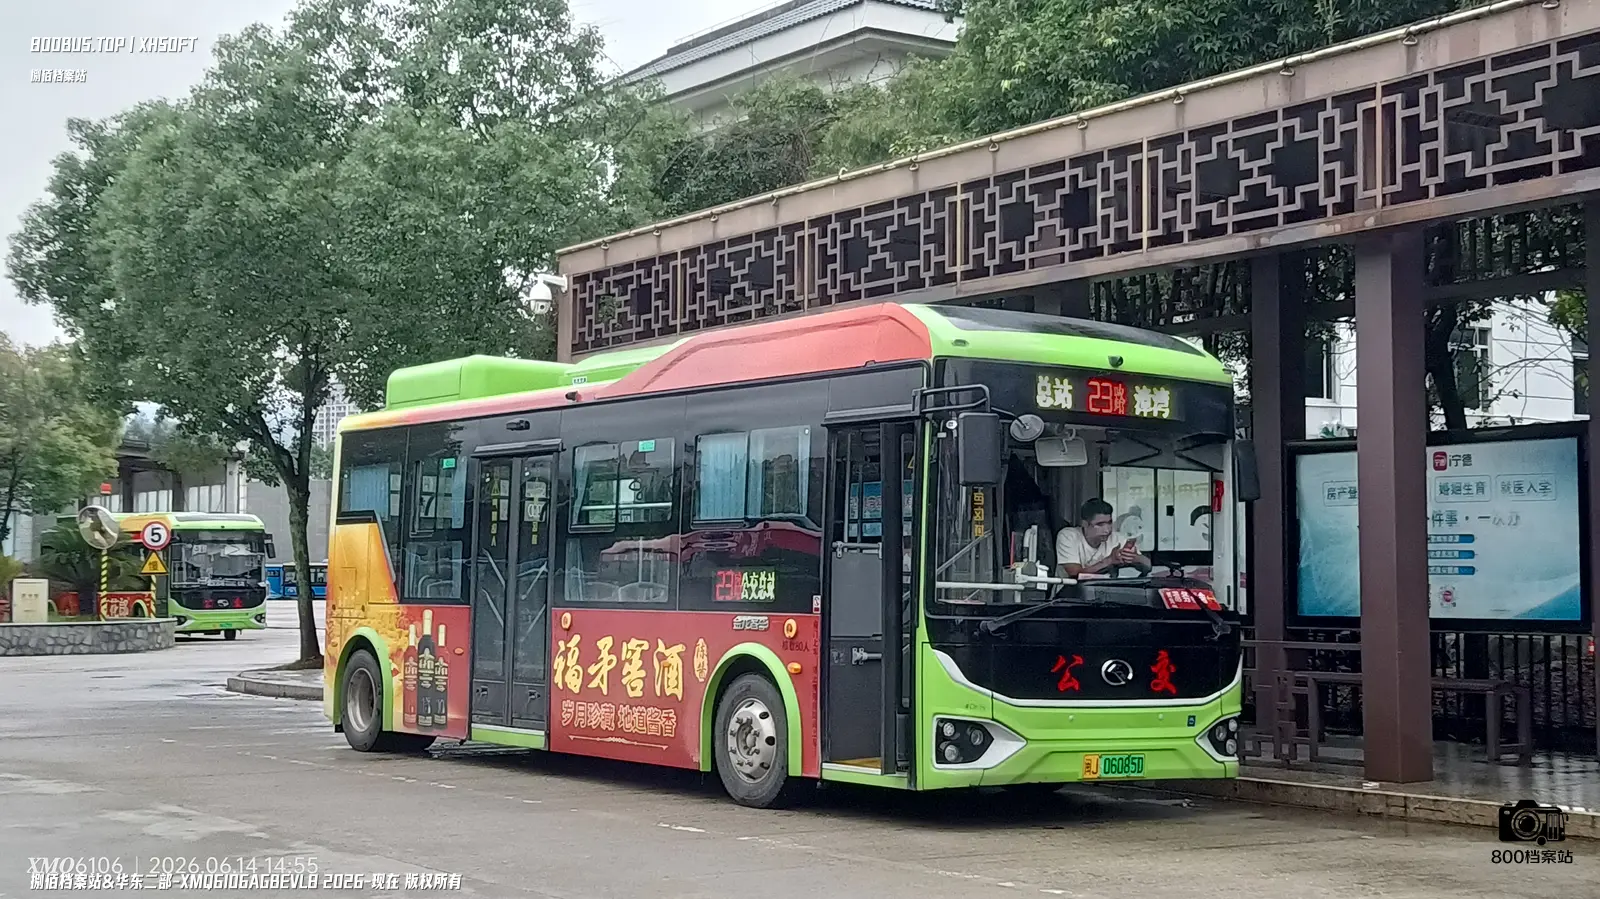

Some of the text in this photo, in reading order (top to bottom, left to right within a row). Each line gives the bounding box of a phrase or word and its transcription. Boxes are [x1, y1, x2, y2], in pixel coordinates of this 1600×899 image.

[1036, 375, 1073, 410] 总站
[1088, 380, 1127, 415] 23路
[1438, 481, 1486, 496] 婚姻生育
[1500, 479, 1553, 497] 就医入学
[150, 526, 162, 543] 5
[1050, 649, 1177, 695] 公 交
[561, 699, 678, 738] 岁月珍藏 地道酱香
